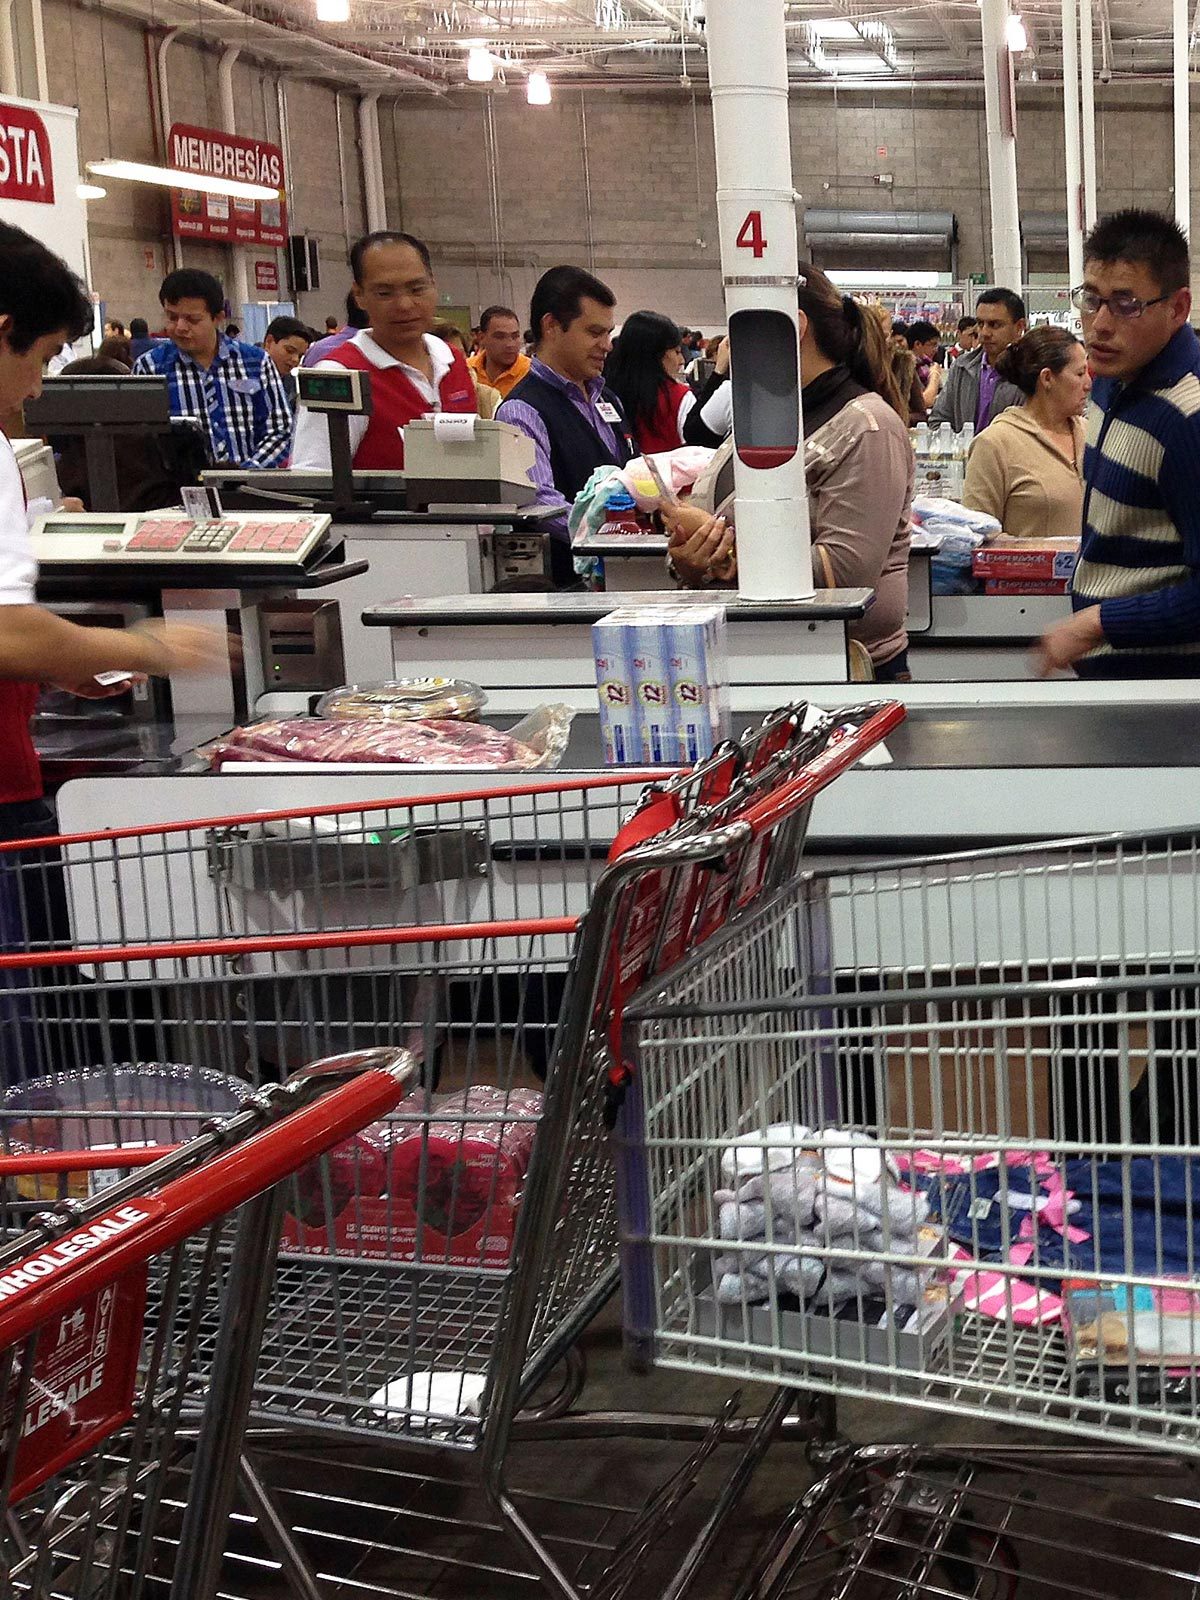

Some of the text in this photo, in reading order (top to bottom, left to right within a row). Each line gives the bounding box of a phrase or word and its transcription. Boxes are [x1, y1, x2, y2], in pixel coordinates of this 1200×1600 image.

[173, 134, 281, 186] MEMBRESÍAS
[736, 210, 768, 258] 4
[1075, 319, 1082, 330] 6
[607, 684, 624, 702] 12
[643, 684, 661, 702] 12
[680, 684, 697, 701] 12
[93, 1288, 112, 1358] AVISO
[23, 1362, 105, 1438] LESALE
